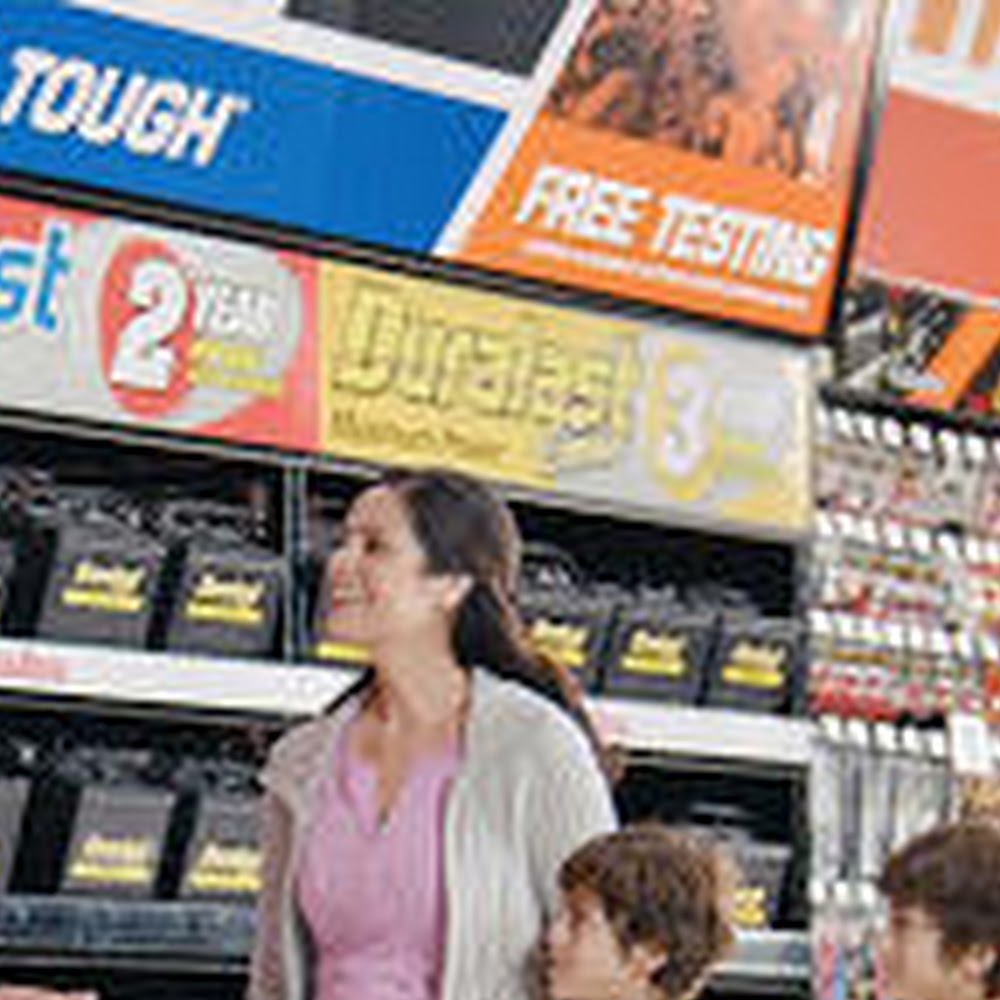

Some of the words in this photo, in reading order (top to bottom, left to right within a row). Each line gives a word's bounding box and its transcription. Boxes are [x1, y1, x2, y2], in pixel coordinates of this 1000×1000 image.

[514, 164, 652, 247] FREE
[651, 193, 837, 288] TESTING
[110, 257, 187, 391] 2
